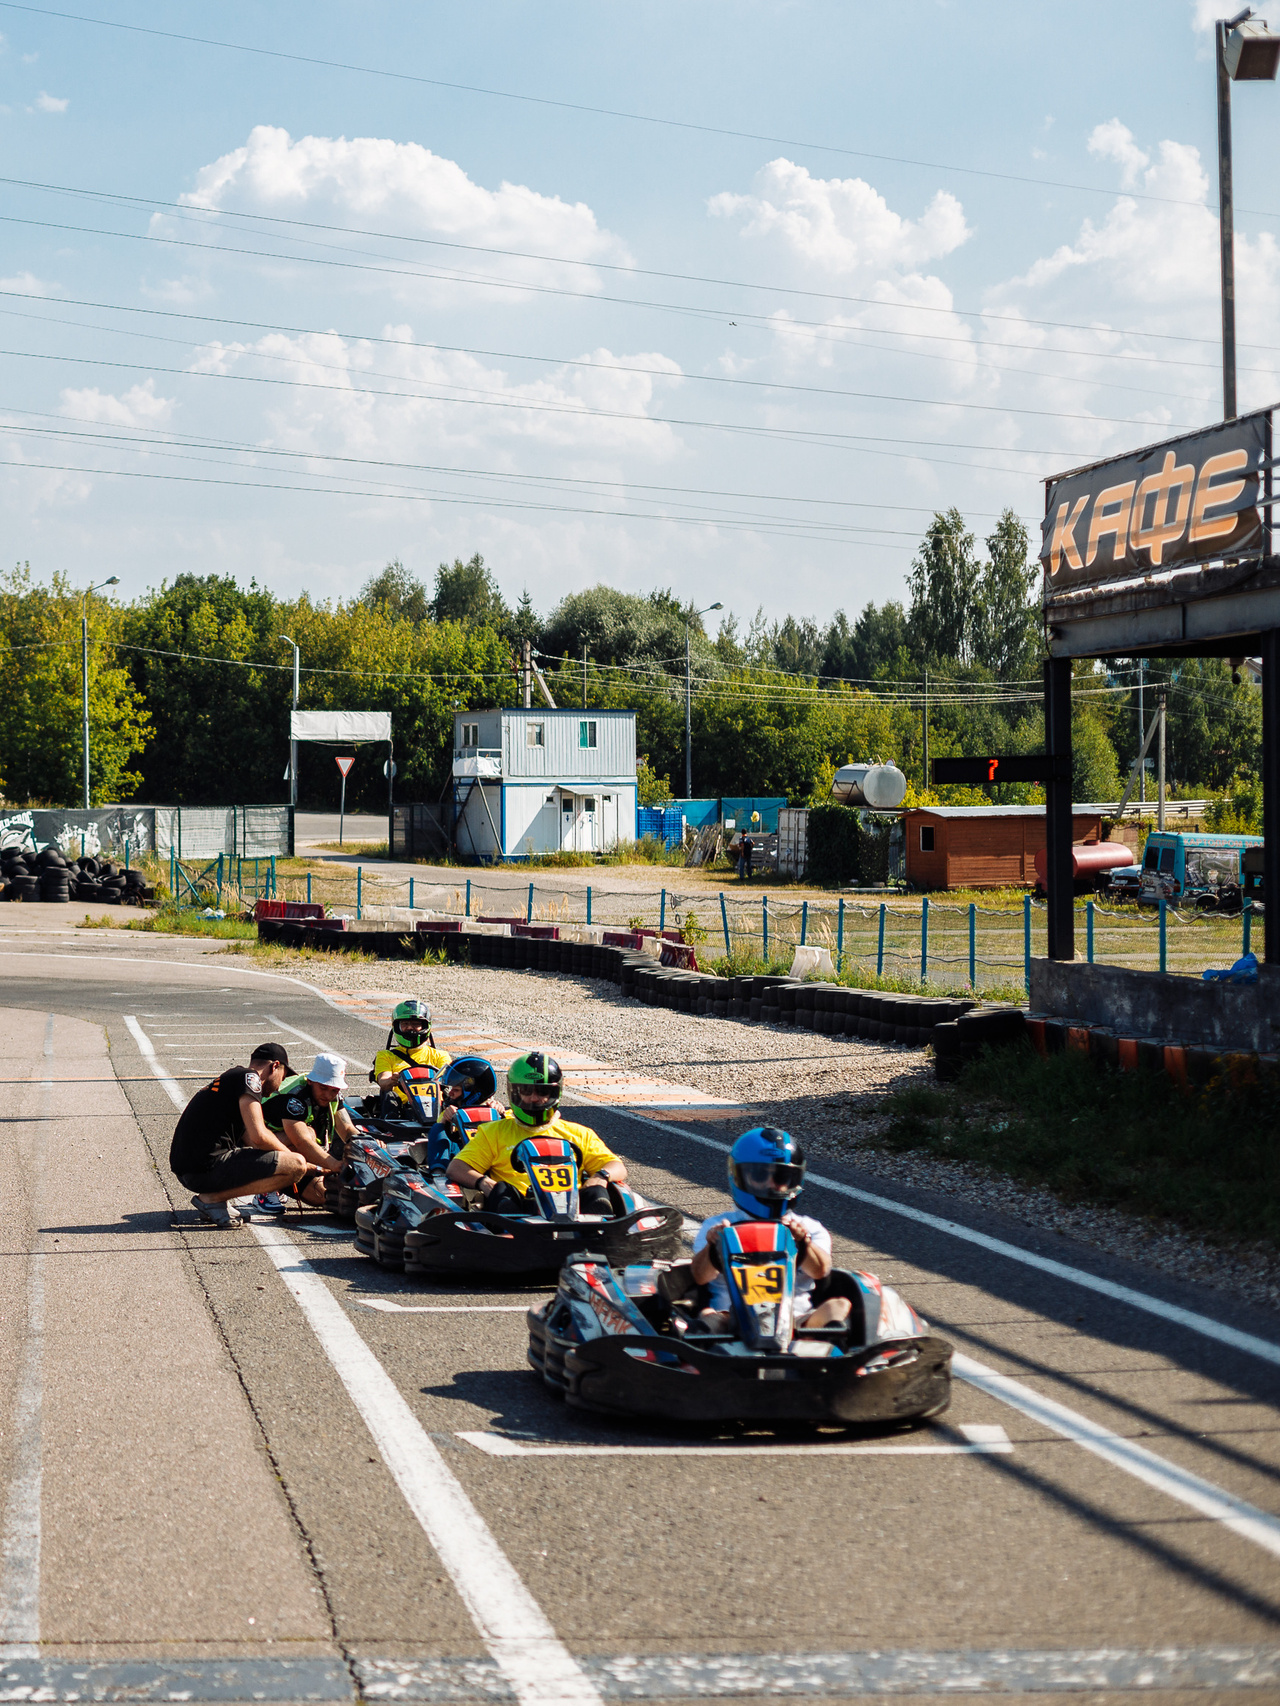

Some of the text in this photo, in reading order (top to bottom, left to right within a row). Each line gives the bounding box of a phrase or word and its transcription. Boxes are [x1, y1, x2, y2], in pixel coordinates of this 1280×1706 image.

[1050, 449, 1249, 577] КАФЕ
[988, 759, 999, 780] 7
[1183, 838, 1242, 848] КАРТОДРОМ
[538, 1167, 572, 1187] 39
[737, 1267, 784, 1296] 19
